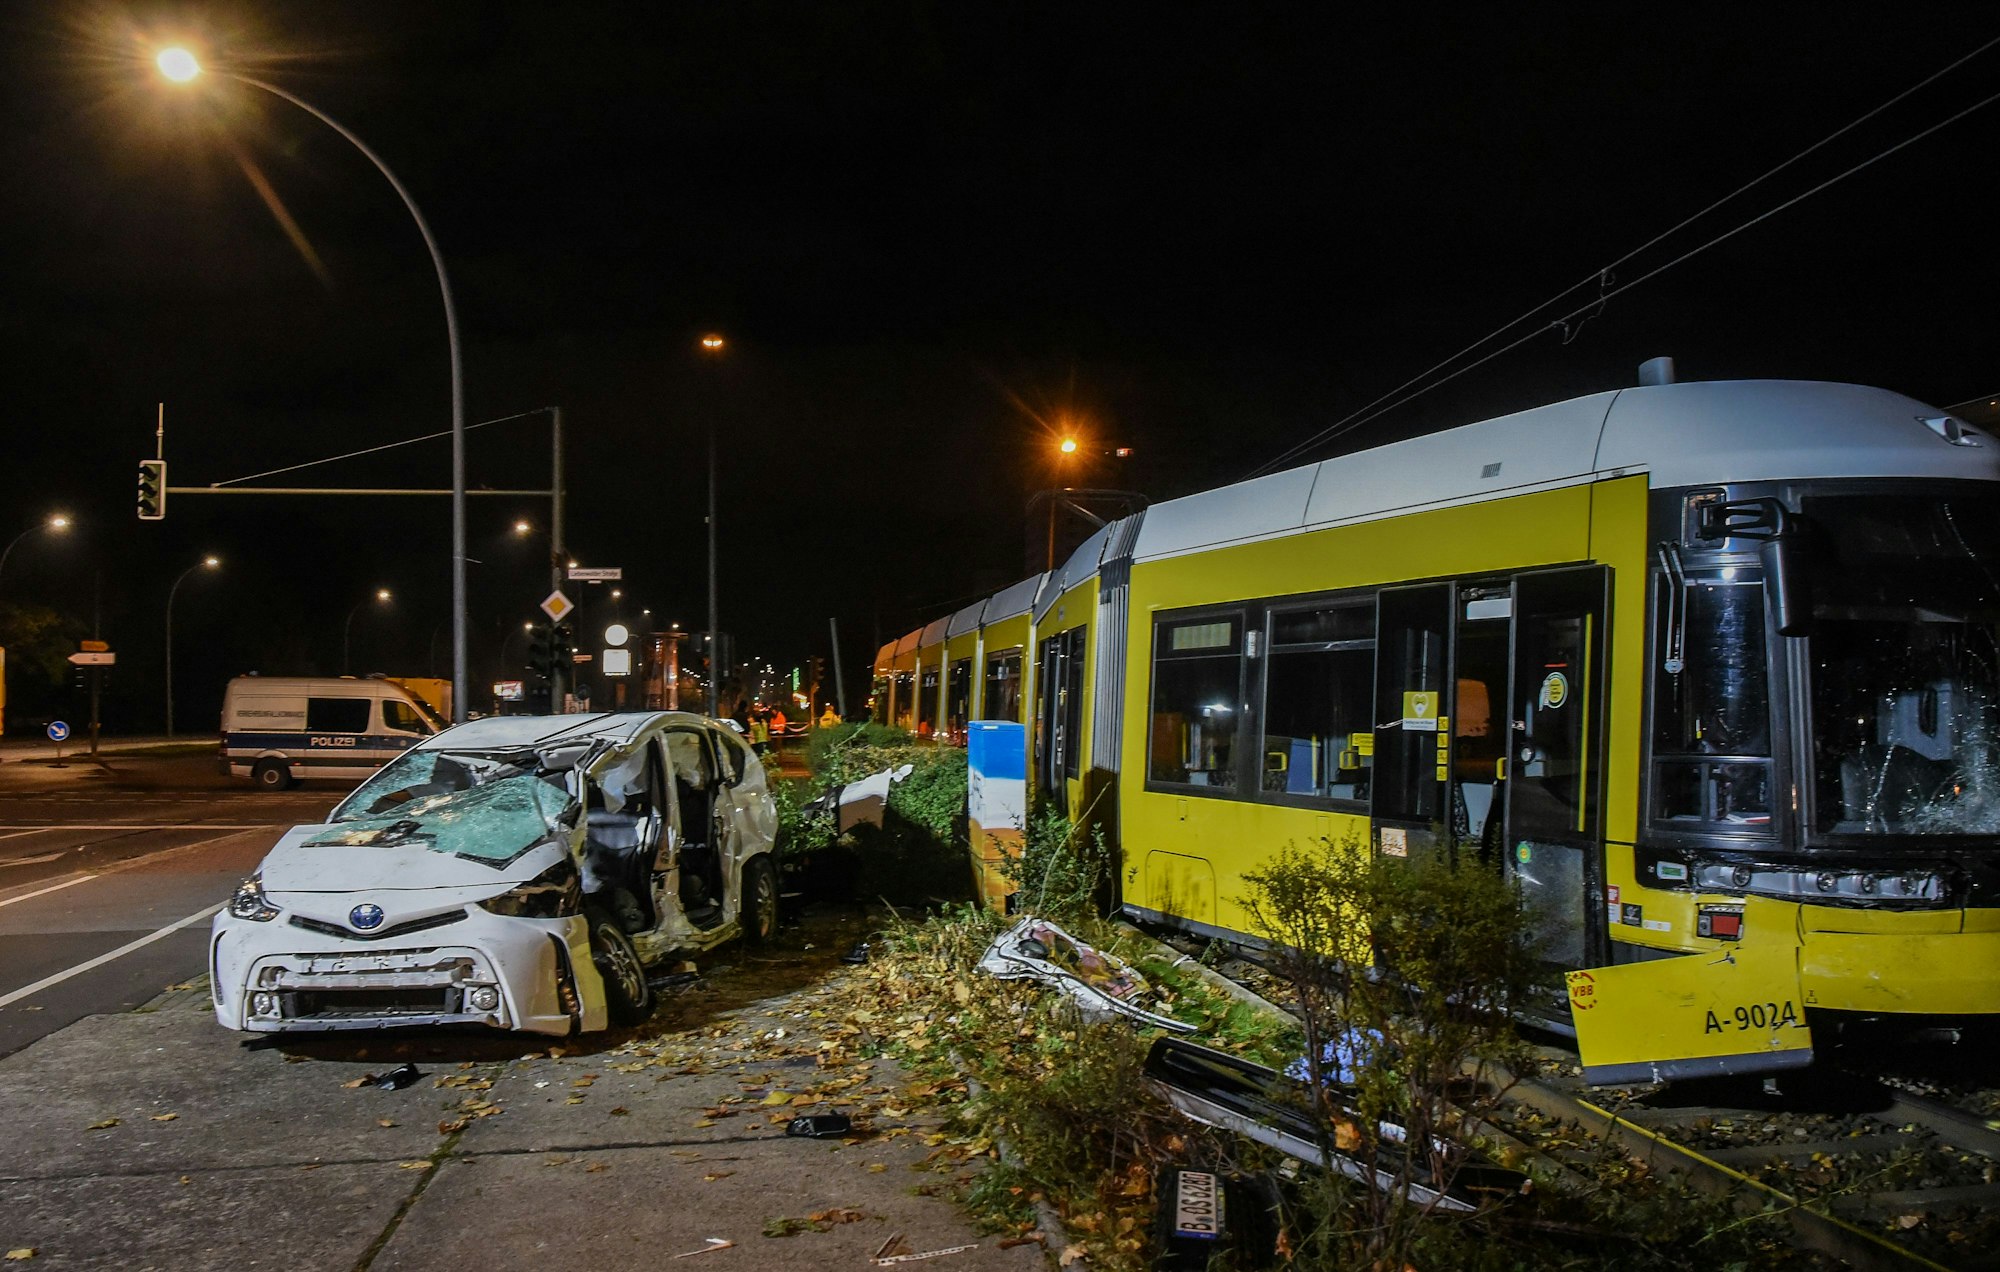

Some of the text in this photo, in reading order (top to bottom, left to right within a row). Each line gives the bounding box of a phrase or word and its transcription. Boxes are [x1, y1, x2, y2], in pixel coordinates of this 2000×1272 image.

[310, 737, 356, 747] POLIZEI
[1572, 984, 1593, 997] VBB
[1704, 1000, 1798, 1035] A-9024
[1180, 1222, 1212, 1231] B
